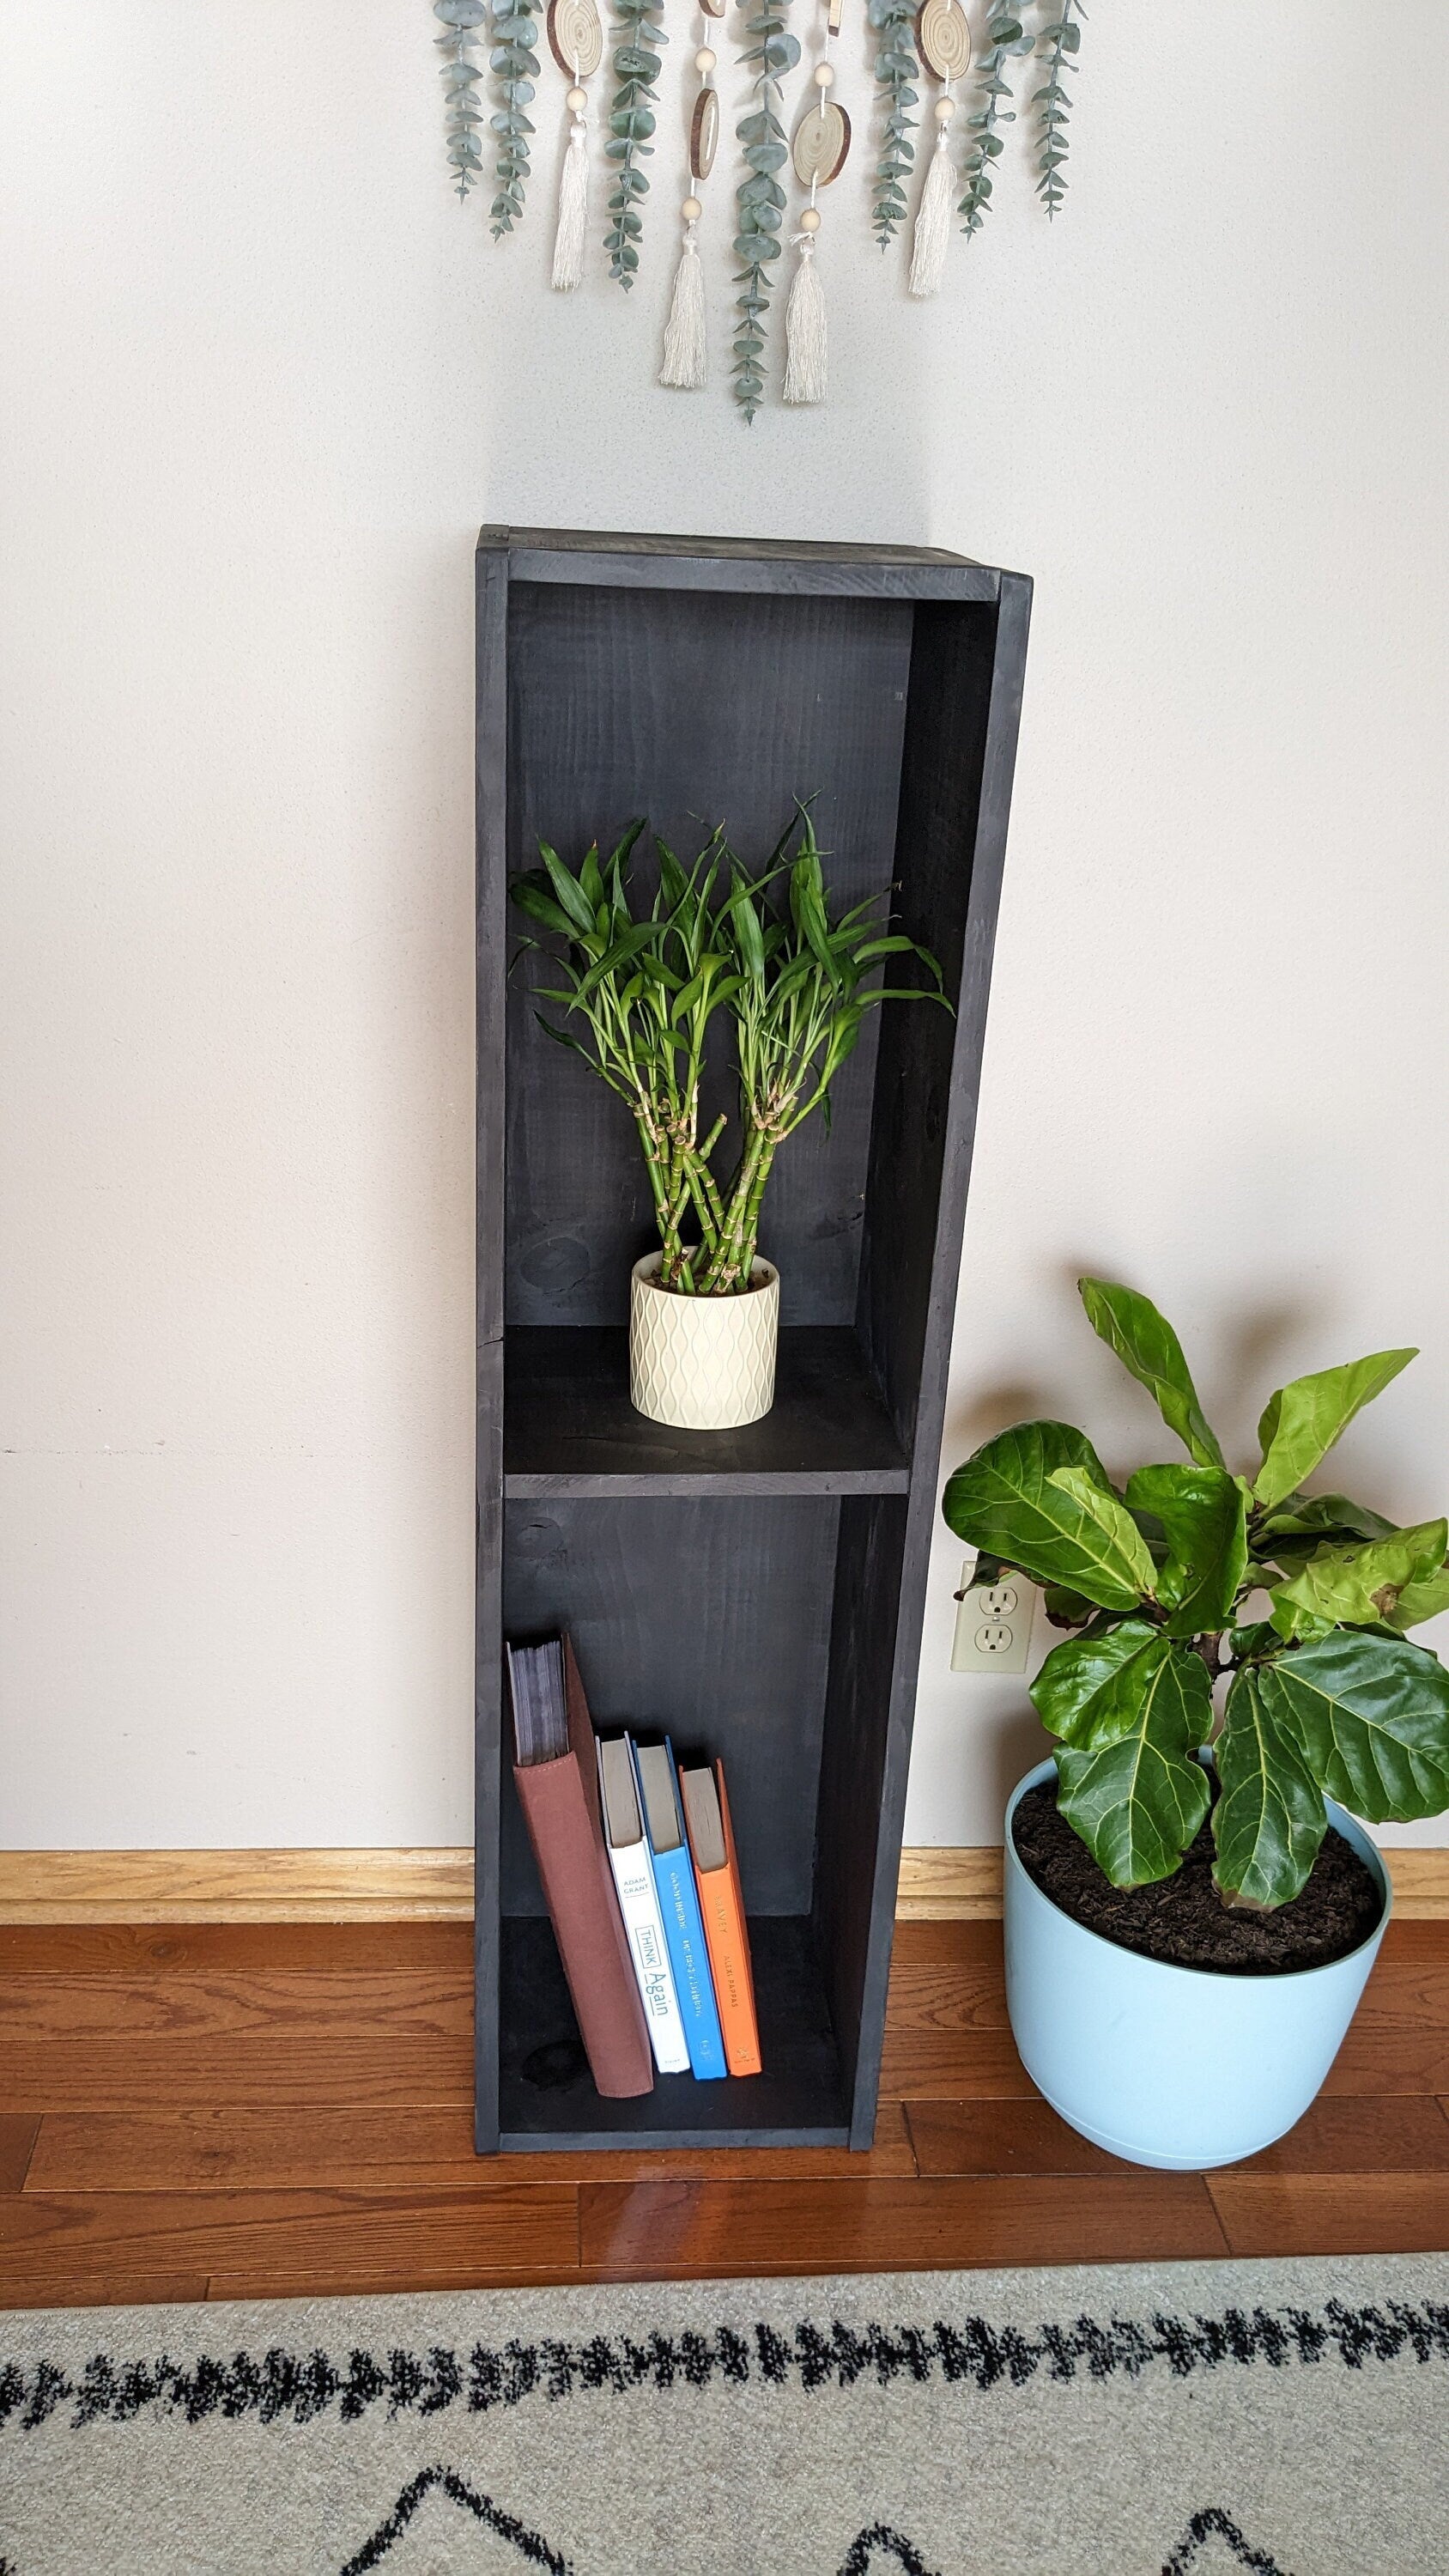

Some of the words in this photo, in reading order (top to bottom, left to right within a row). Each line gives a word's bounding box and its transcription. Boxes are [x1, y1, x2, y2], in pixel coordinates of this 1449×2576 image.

[623, 1877, 646, 1886] ADAM
[623, 1883, 650, 1894] GRANT
[640, 1929, 658, 1965] THINK
[724, 1955, 733, 1977] ALEXI
[646, 1972, 671, 2016] Again
[727, 1979, 738, 2008] PAPPAS
